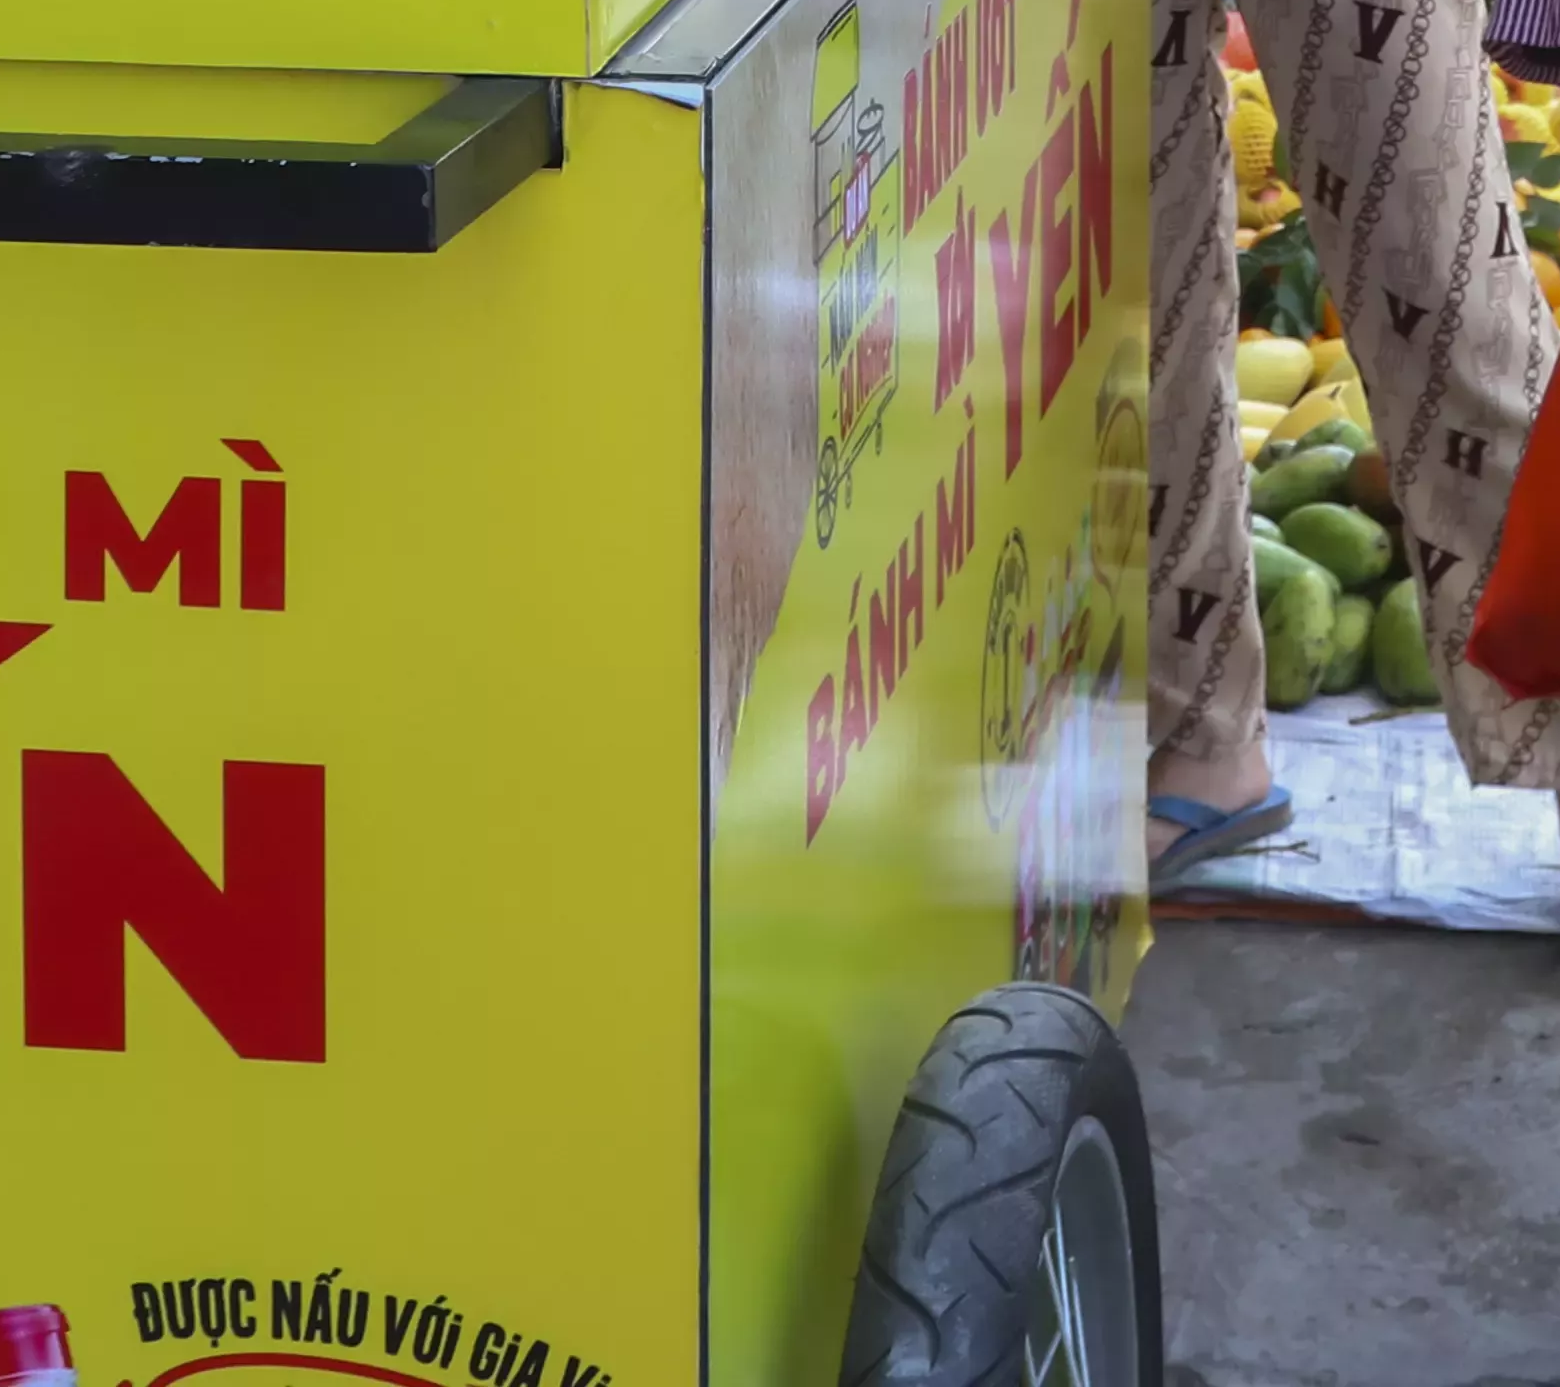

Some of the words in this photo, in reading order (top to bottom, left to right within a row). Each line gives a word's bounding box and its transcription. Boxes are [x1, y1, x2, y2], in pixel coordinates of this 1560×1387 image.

[902, 2, 968, 241] BÁNH
[63, 437, 287, 612] MÌ
[805, 510, 925, 850] BÁNH
[935, 392, 976, 612] MÌ
[130, 1276, 258, 1349] ĐƯỢC
[270, 1266, 371, 1349] NẤU
